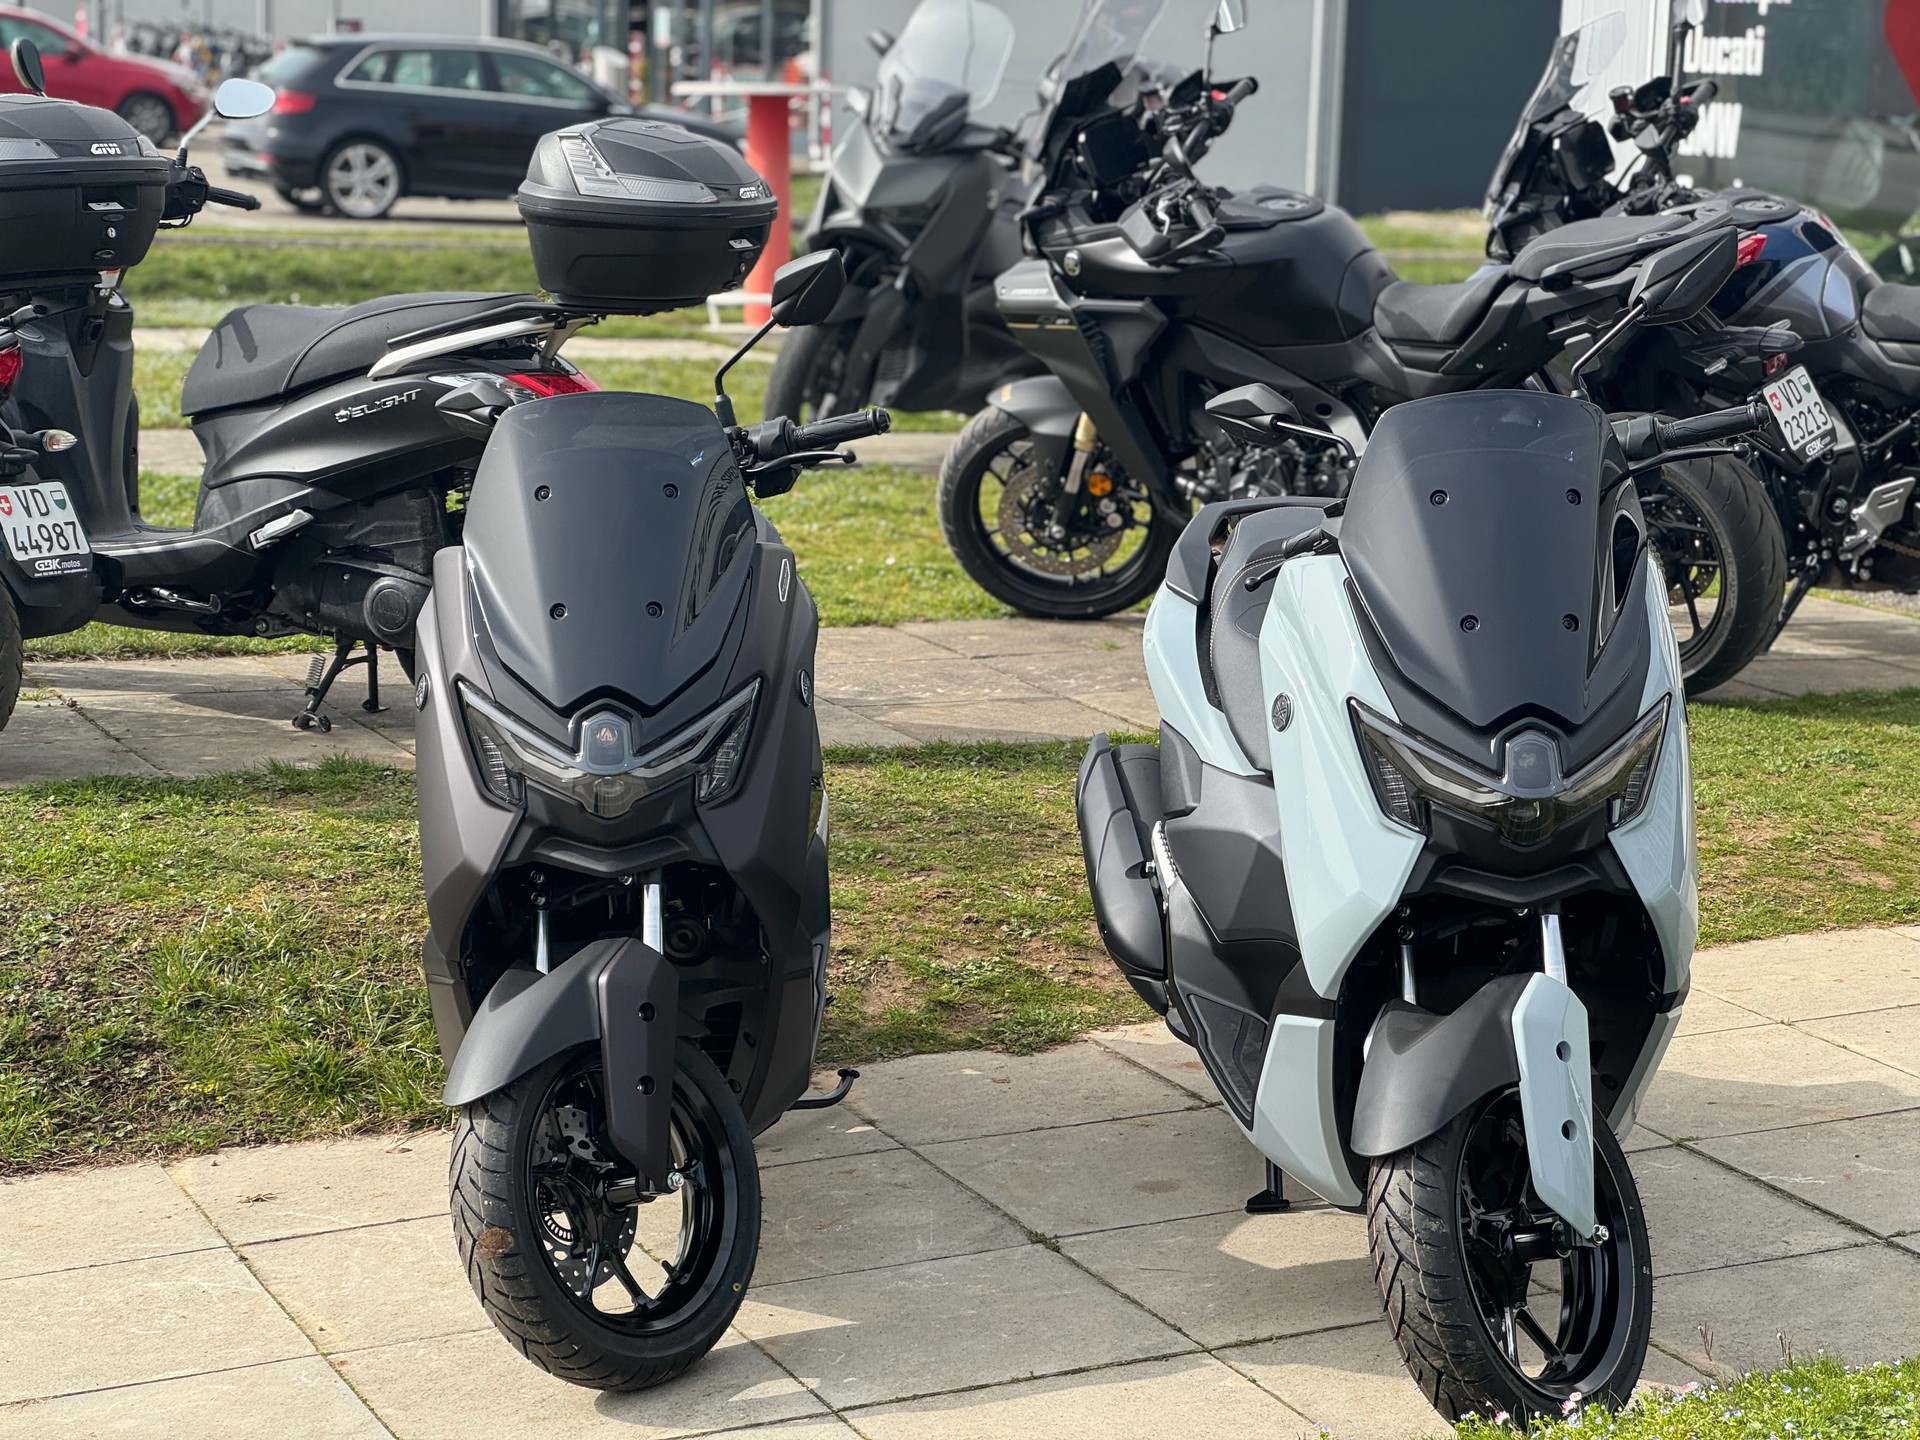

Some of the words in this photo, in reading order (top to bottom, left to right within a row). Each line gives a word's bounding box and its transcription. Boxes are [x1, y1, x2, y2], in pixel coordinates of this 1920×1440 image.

[1683, 24, 1765, 76] Ducati
[90, 143, 121, 155] GIVI
[334, 388, 421, 423] DELIGHT
[1777, 378, 1803, 408] VD
[1784, 401, 1828, 446] 23213
[13, 488, 50, 518] VD
[12, 521, 80, 555] 44987
[34, 558, 62, 572] GBK
